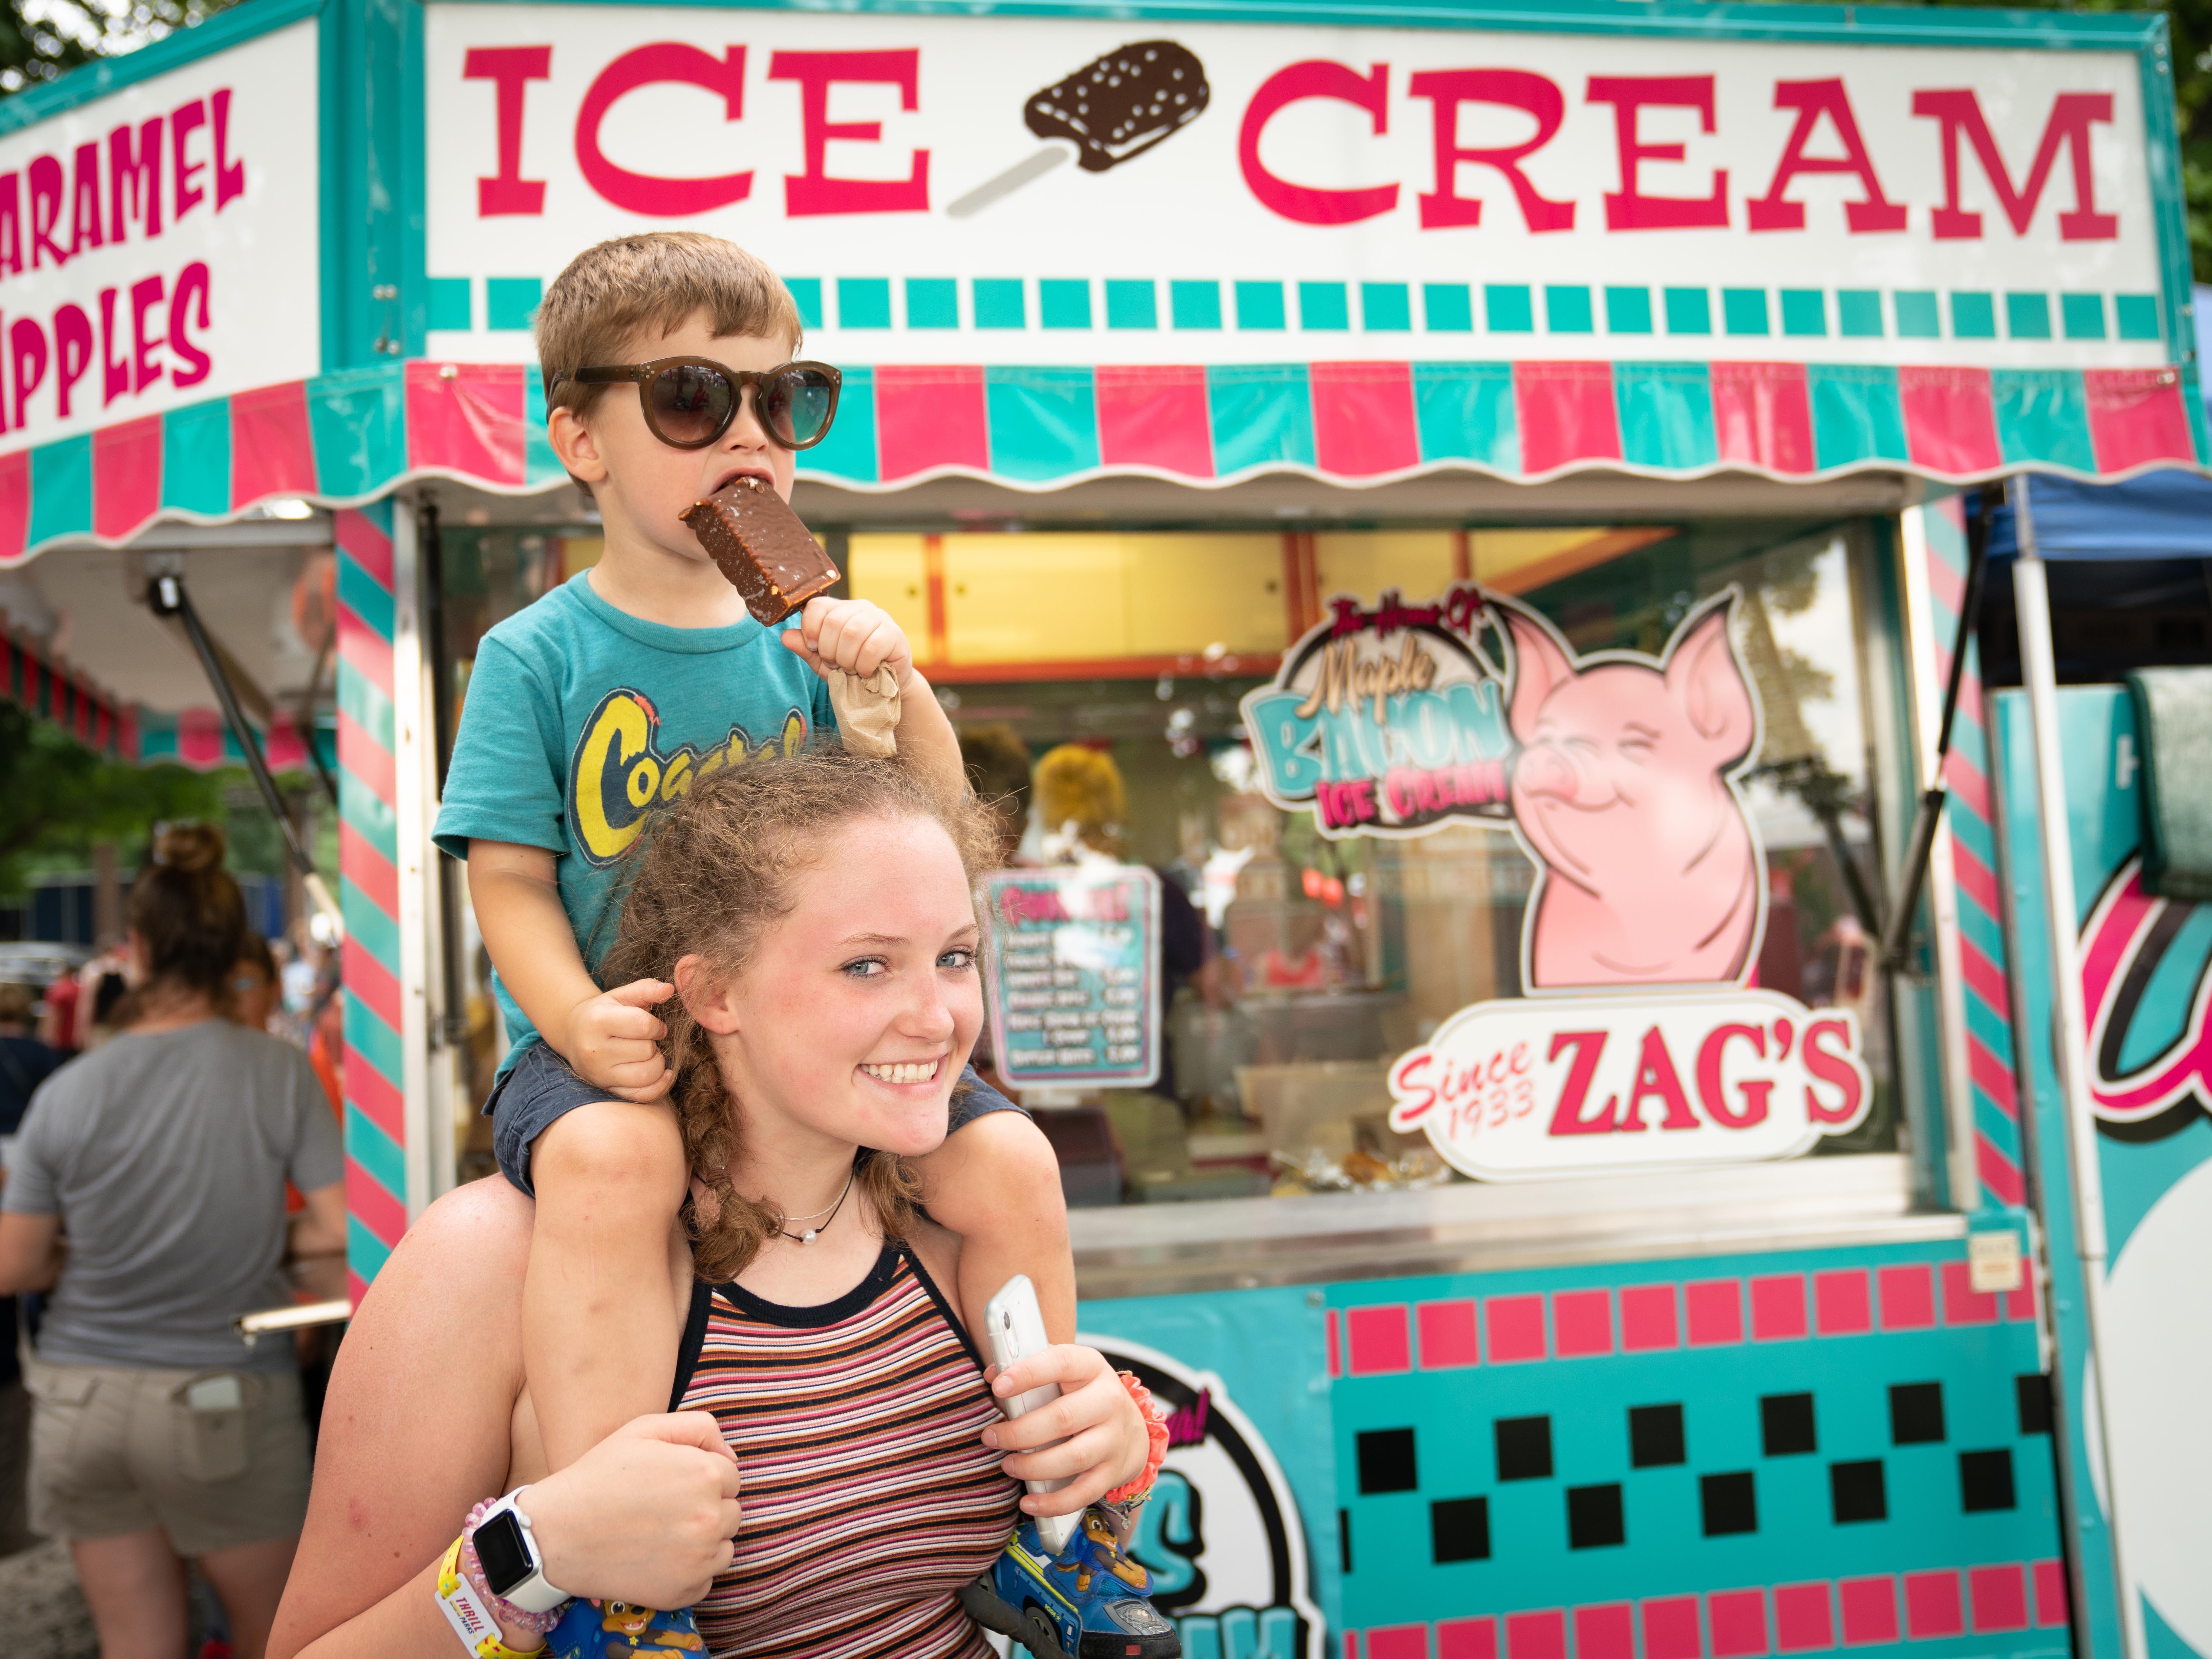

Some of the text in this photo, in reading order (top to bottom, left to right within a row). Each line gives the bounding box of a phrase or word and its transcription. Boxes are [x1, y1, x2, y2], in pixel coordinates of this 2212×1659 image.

[462, 41, 2118, 241] ICE CREAM
[0, 261, 212, 437] PPLES
[1295, 634, 1435, 725] Maple
[1251, 678, 1510, 794] BACON
[1315, 759, 1507, 828] ICE CREAM
[1397, 1041, 1532, 1122] Since
[1449, 1079, 1535, 1140] 1933
[1548, 1018, 1862, 1136] ZAG'S
[455, 1597, 484, 1632] THRILL
[459, 1617, 475, 1635] PARKS
